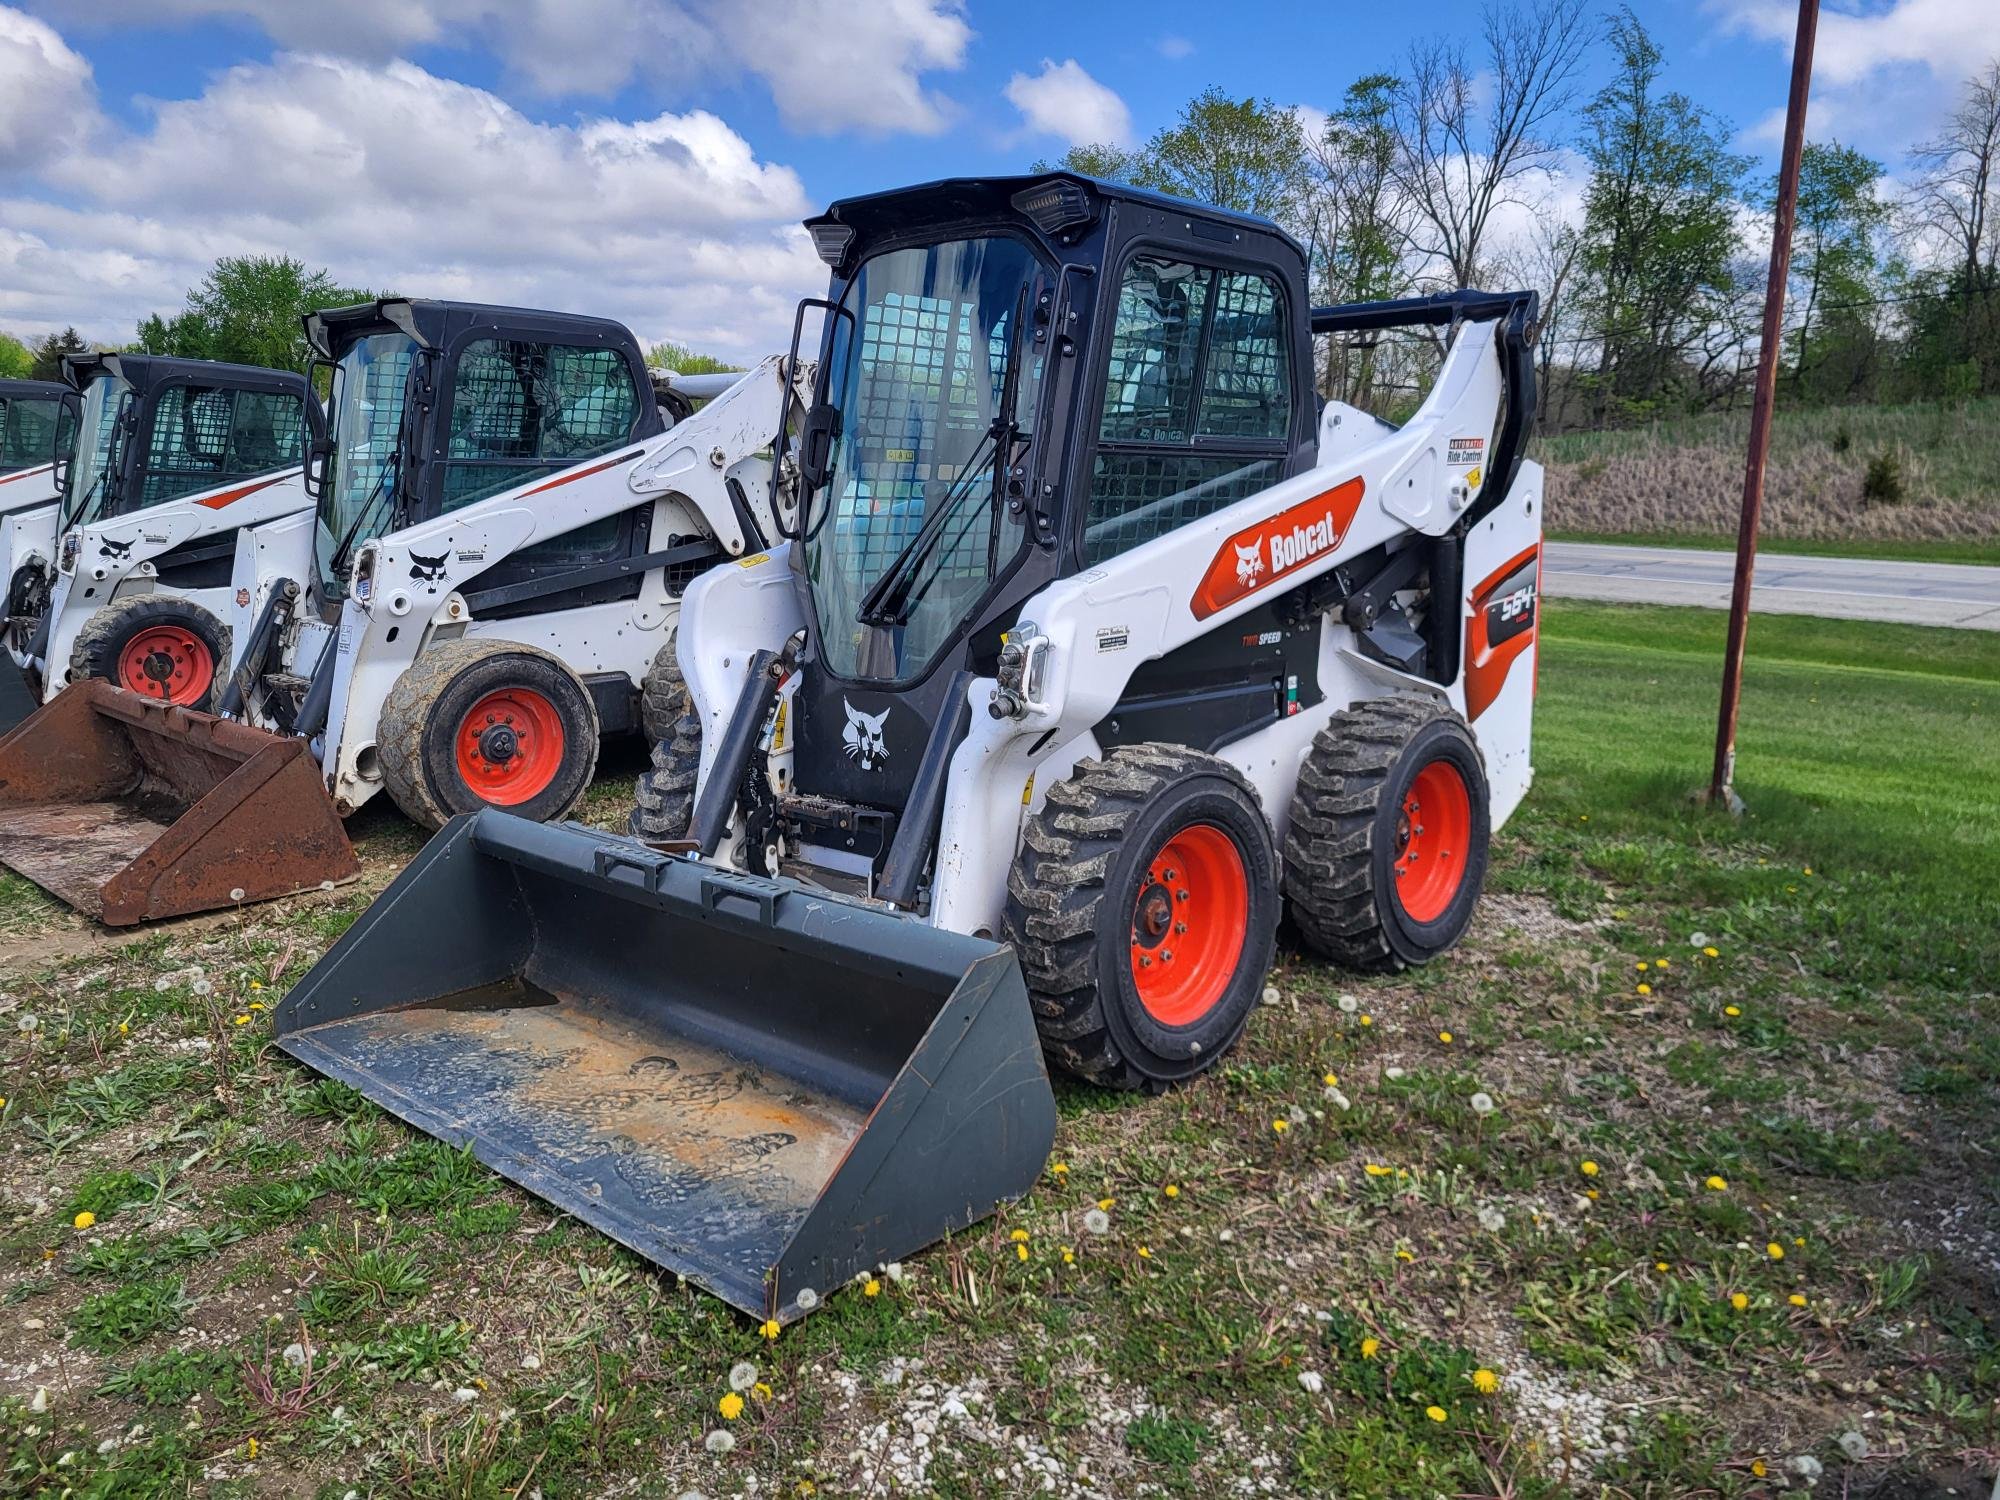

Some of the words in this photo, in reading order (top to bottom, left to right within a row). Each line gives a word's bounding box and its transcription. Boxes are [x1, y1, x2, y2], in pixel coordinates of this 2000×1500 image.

[1449, 439, 1484, 449] AUTOMATIC
[1447, 451, 1461, 463] Ride
[1462, 450, 1483, 462] Control
[1269, 511, 1335, 574] Bobcat
[1243, 634, 1258, 648] TWO
[1258, 631, 1282, 646] SPEED
